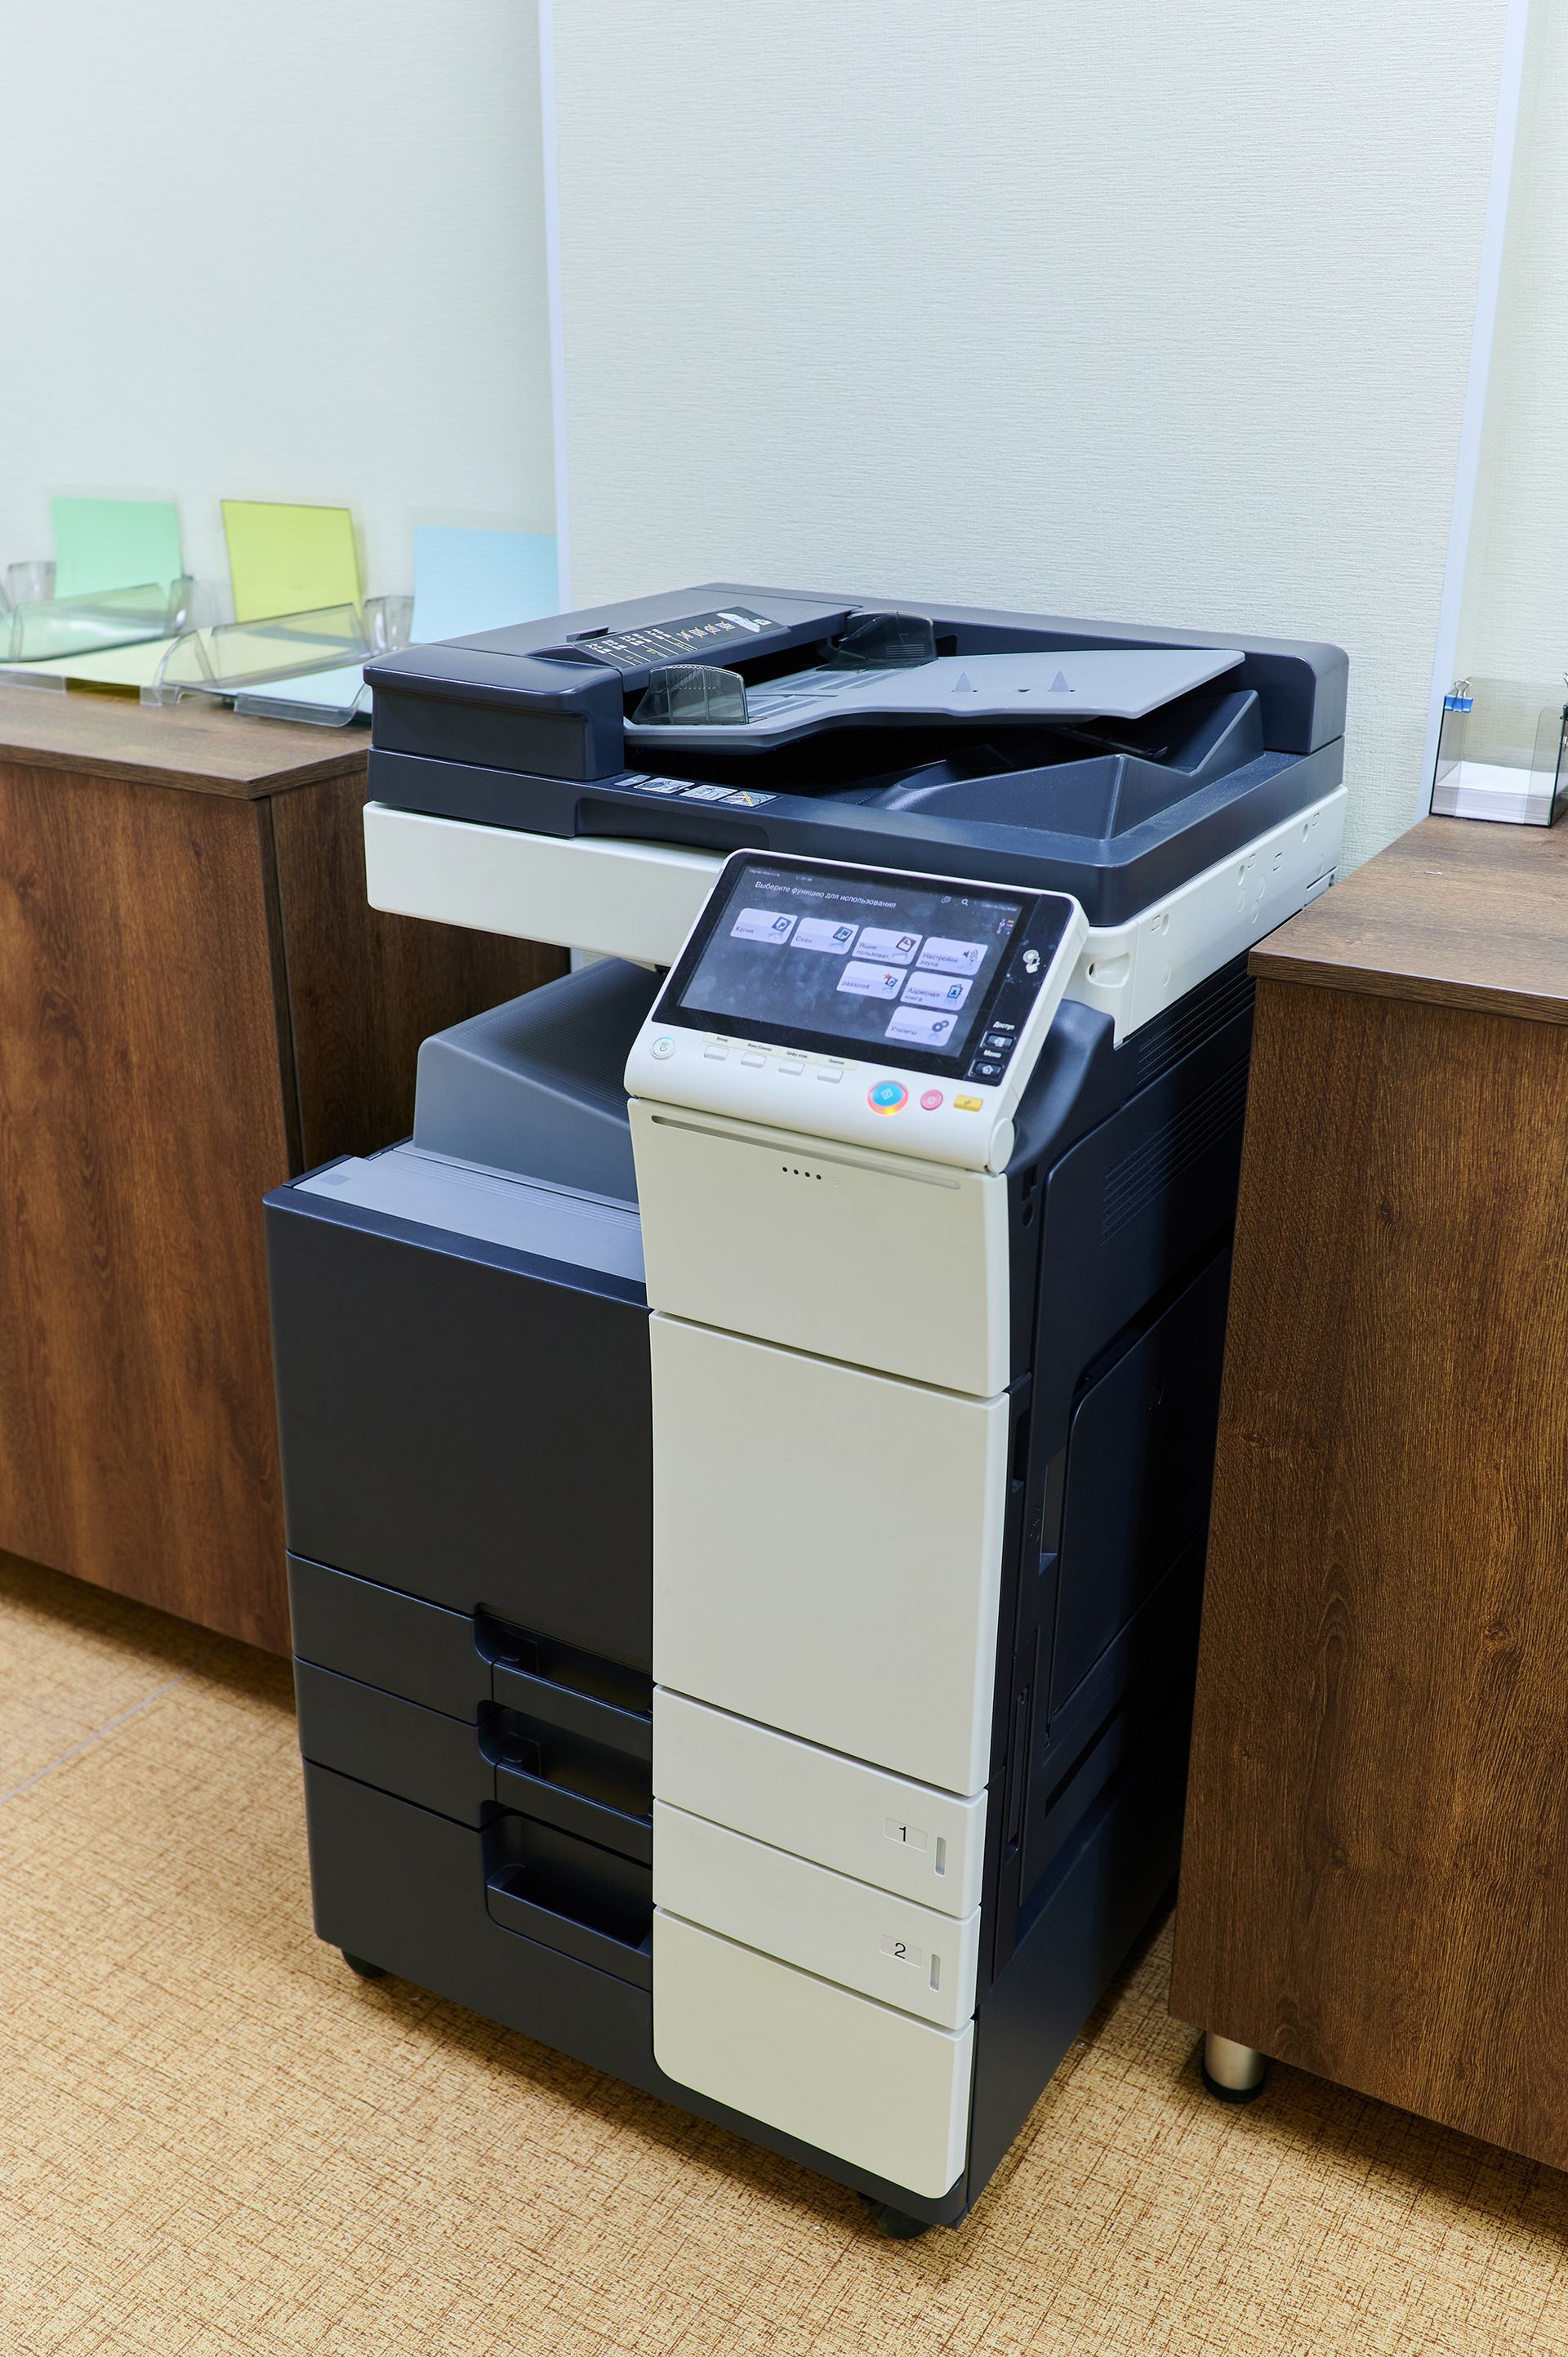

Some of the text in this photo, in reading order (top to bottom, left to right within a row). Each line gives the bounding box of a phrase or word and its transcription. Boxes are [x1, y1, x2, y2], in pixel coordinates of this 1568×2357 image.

[755, 880, 791, 892] Выберите
[791, 887, 824, 898] функцию
[840, 894, 896, 908] использования
[923, 953, 958, 963] Настройки
[841, 981, 870, 991] passport
[907, 987, 940, 998] Адресная
[891, 1026, 918, 1036] Утилиты
[899, 1826, 906, 1842] 1
[894, 1942, 906, 1960] 2
